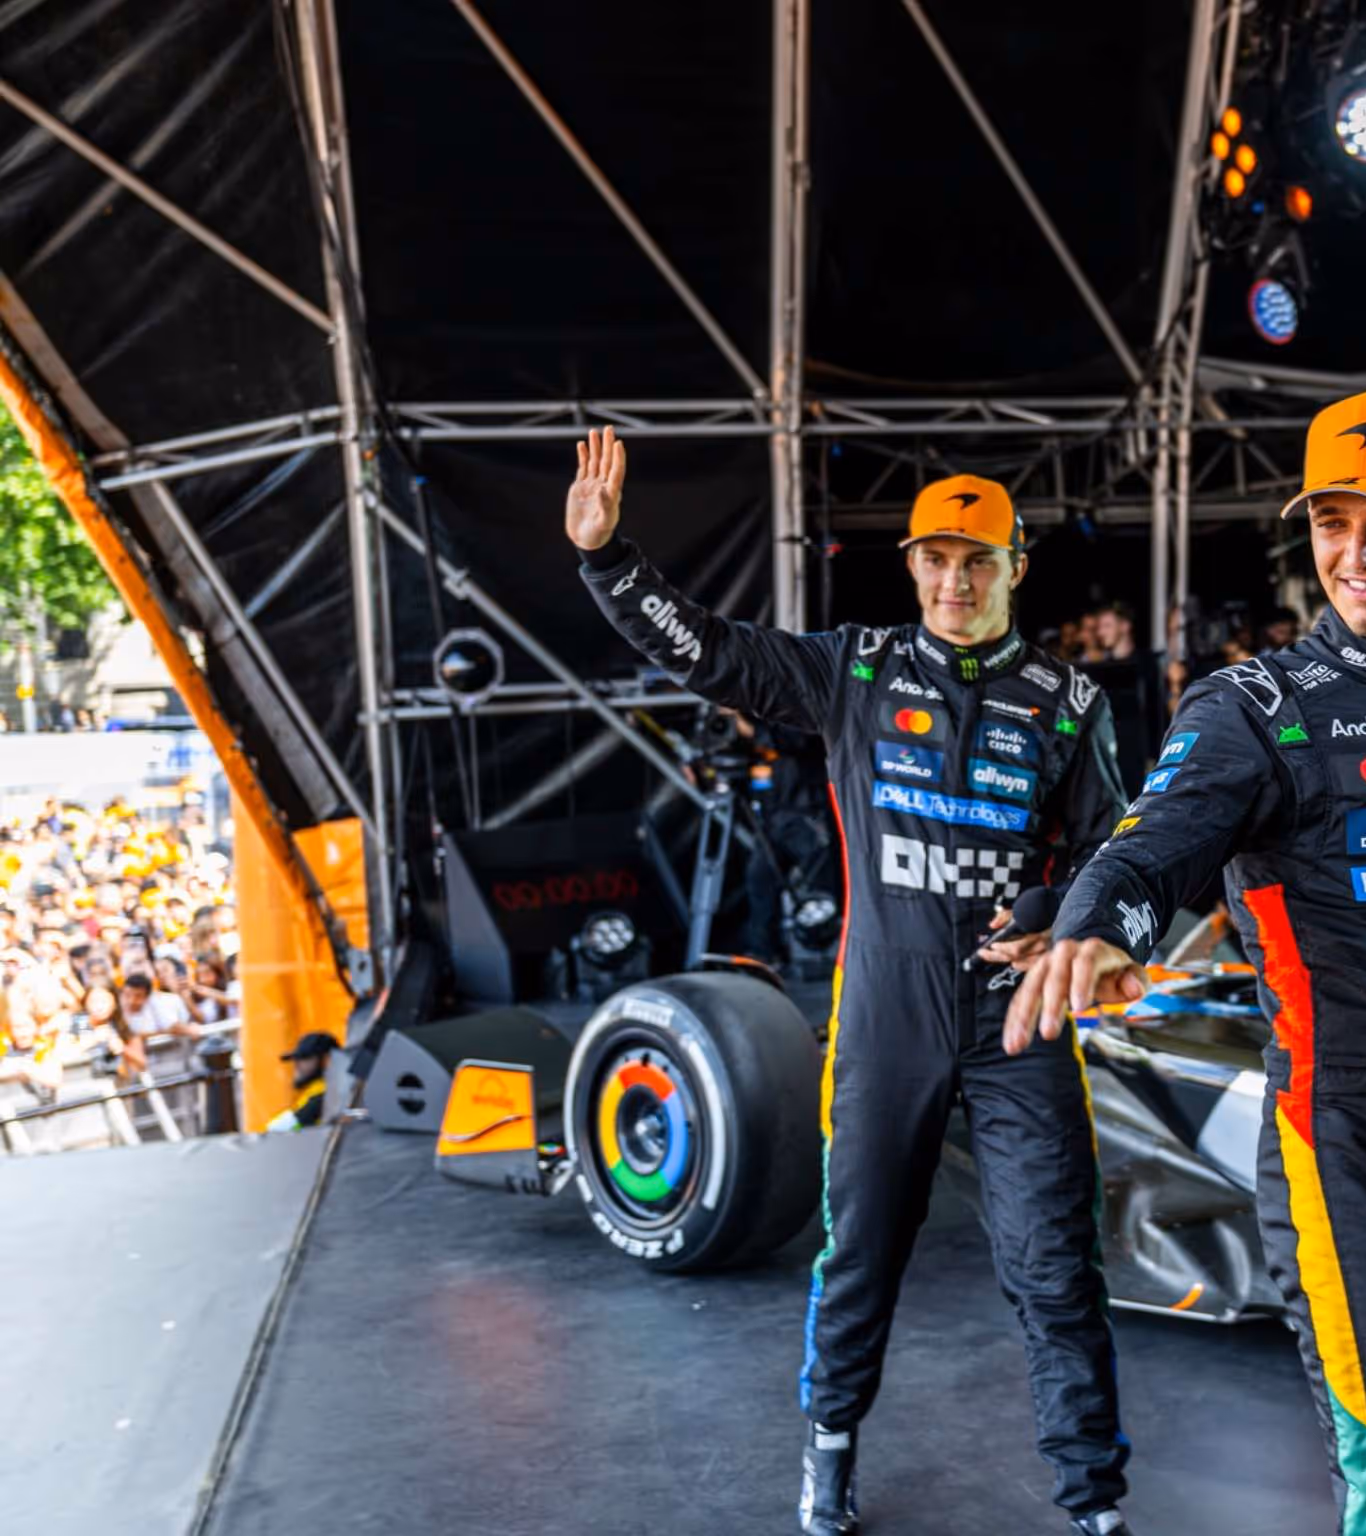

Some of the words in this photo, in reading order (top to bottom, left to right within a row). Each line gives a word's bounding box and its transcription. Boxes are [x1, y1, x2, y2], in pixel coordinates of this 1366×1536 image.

[896, 763, 932, 778] WORLD
[973, 766, 1029, 792] allwyn
[880, 786, 925, 809] DELL
[592, 1211, 663, 1259] ZERO
